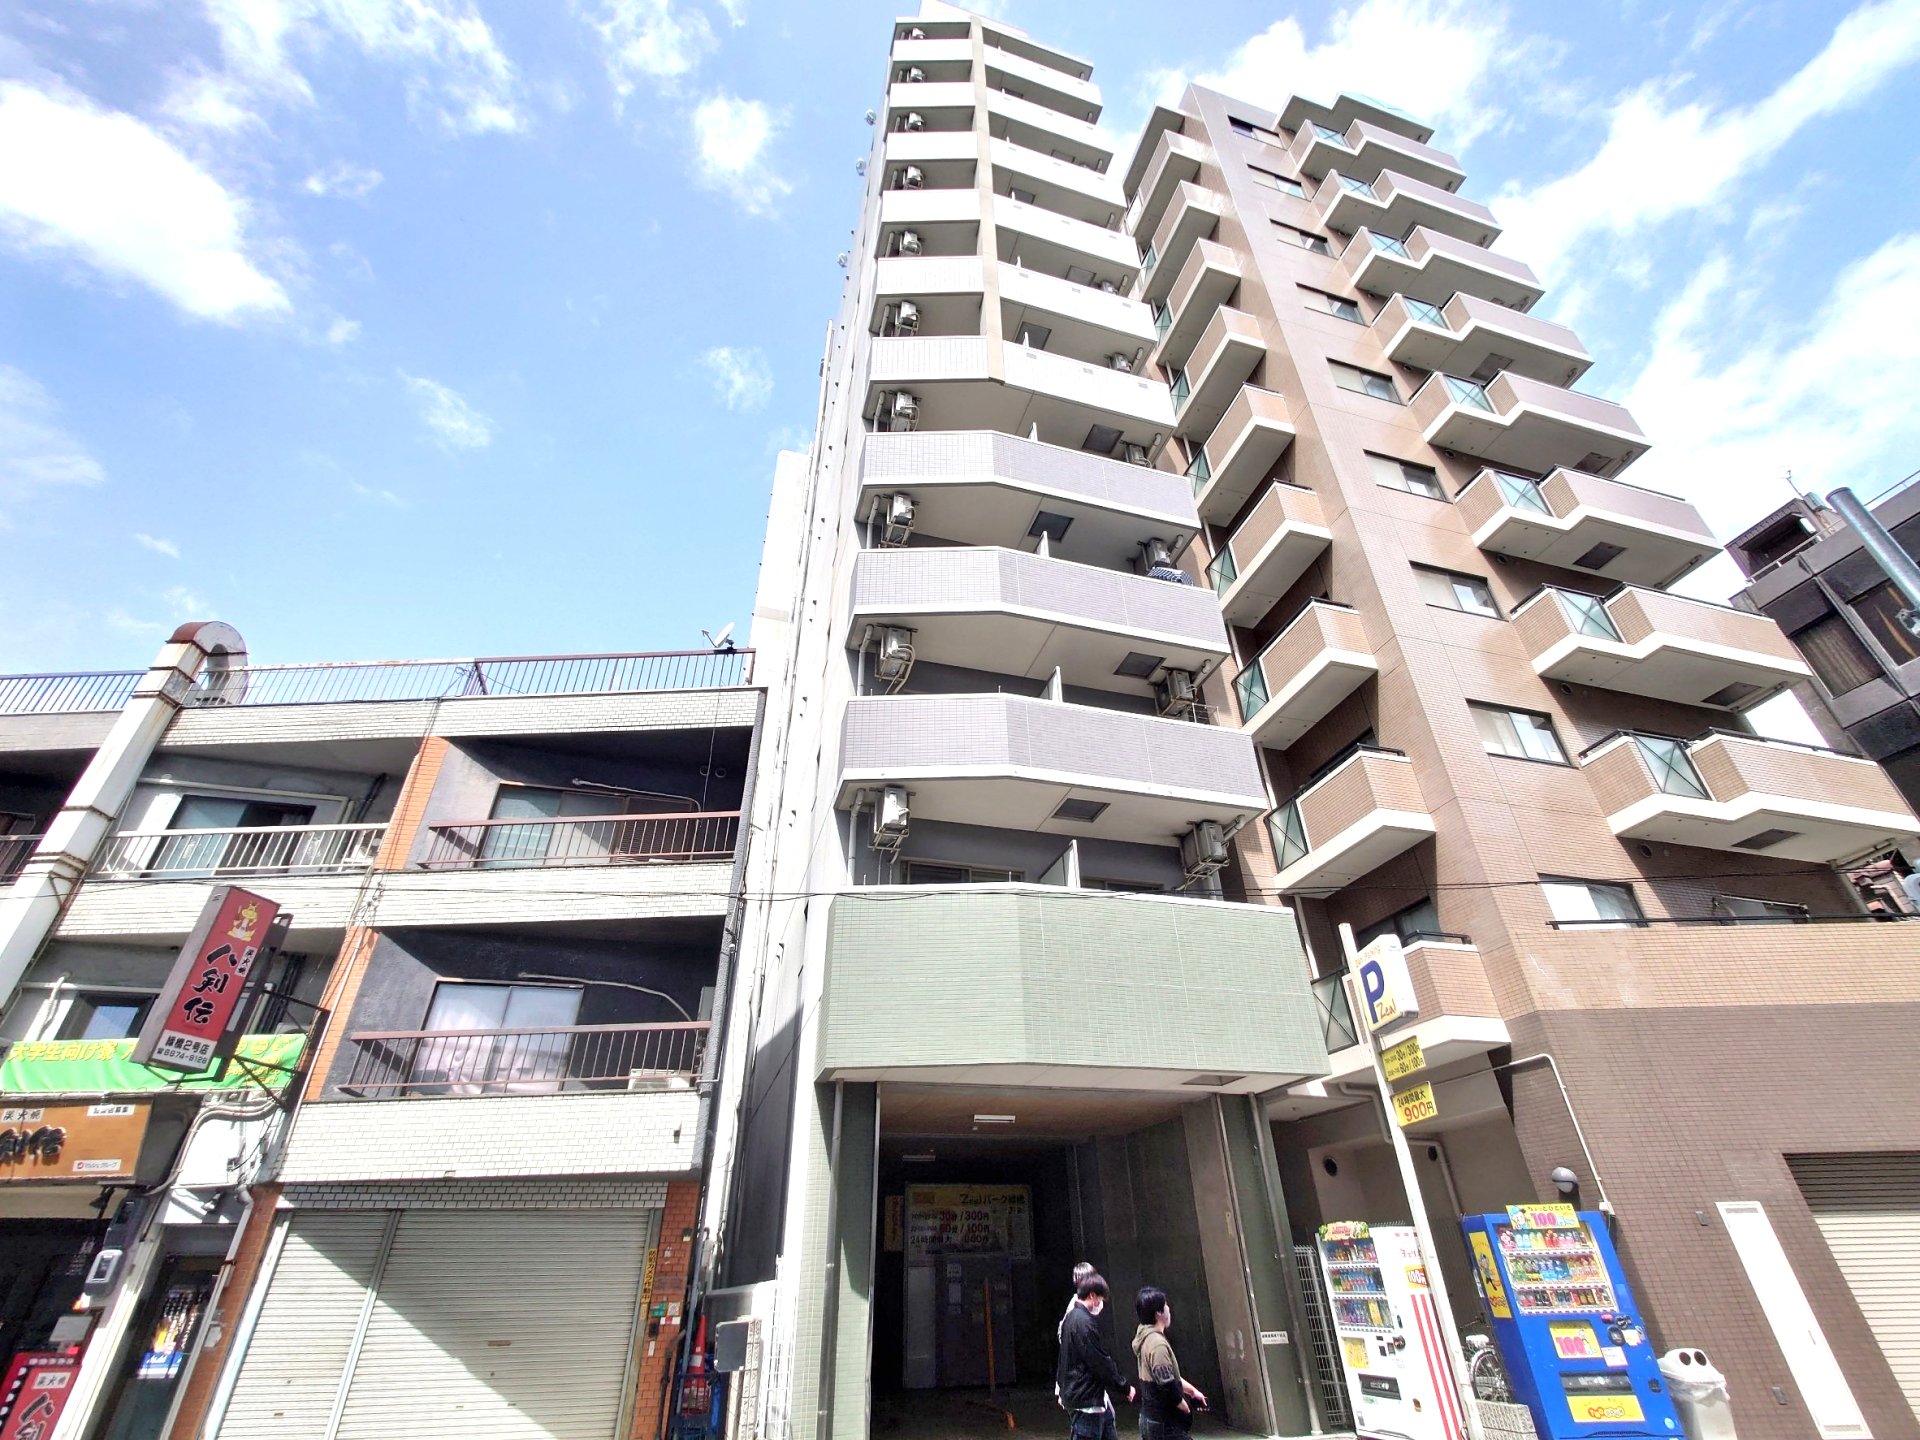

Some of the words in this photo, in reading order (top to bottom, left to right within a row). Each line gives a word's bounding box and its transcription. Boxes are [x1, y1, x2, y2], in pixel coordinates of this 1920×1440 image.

[184, 943, 239, 1024] 八剣伝
[1360, 960, 1385, 1025] P
[1404, 1101, 1435, 1122] 900円
